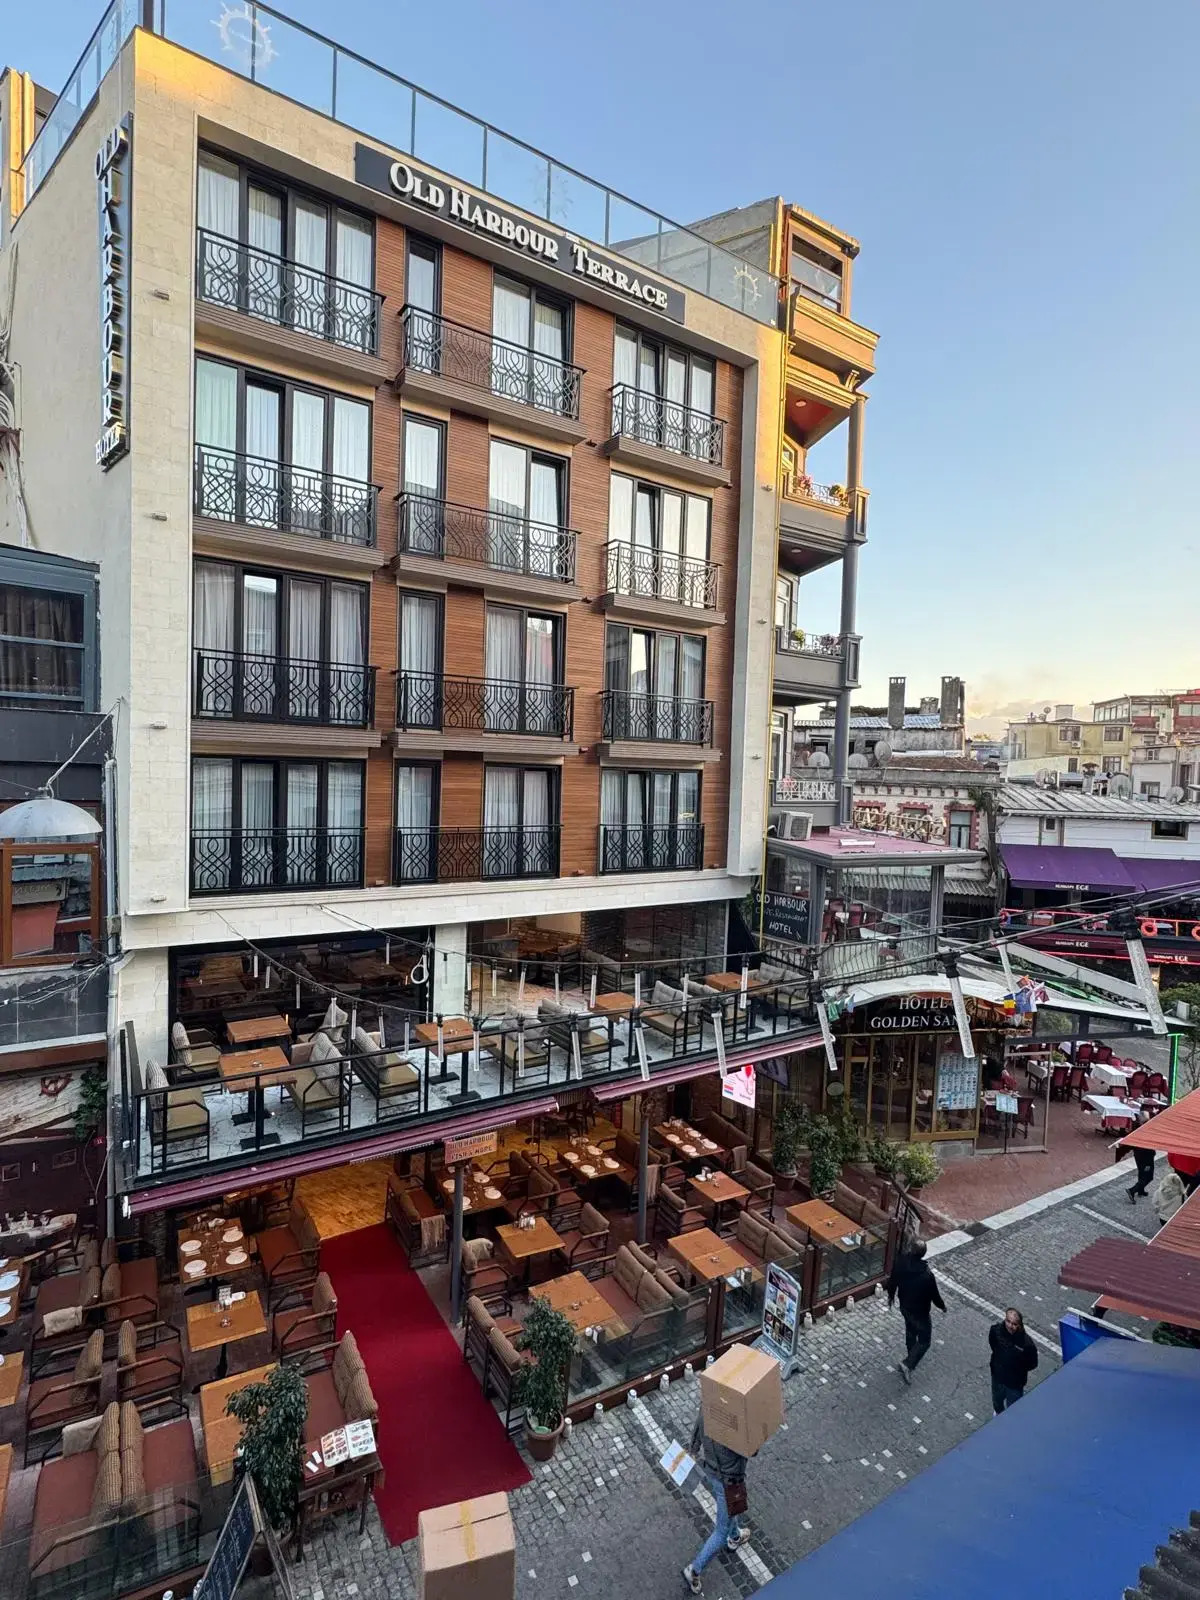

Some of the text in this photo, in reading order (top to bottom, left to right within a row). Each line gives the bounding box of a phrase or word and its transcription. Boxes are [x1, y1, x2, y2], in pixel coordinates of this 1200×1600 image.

[95, 123, 121, 180] OLD
[390, 162, 668, 310] OLD HARBOUR TERRACE
[756, 893, 807, 913] OD HARBOUR
[769, 922, 792, 934] HOTEL
[899, 997, 948, 1010] HOTEL
[870, 1015, 930, 1029] GOLDEN
[474, 1145, 493, 1155] MORE
